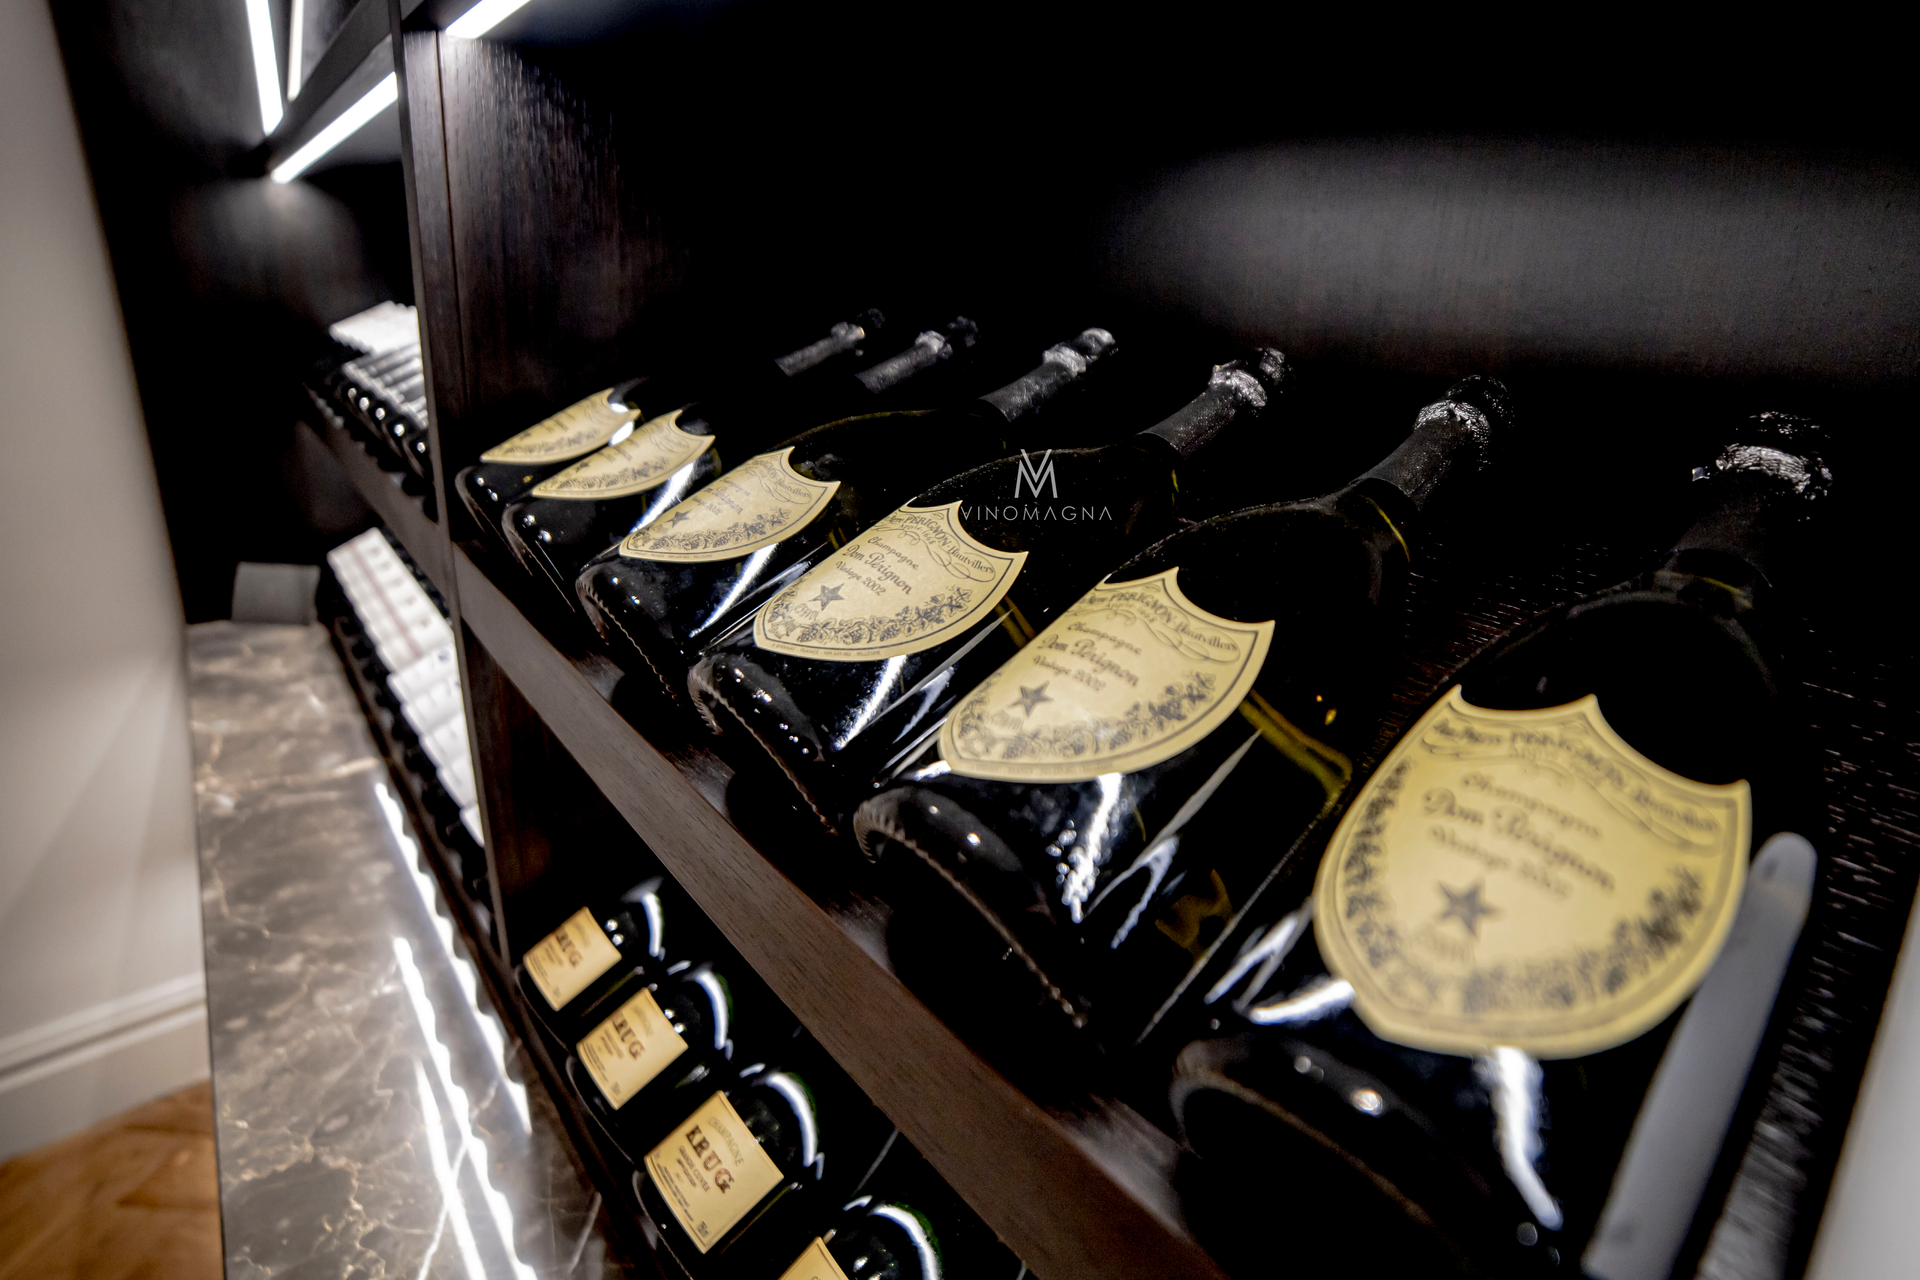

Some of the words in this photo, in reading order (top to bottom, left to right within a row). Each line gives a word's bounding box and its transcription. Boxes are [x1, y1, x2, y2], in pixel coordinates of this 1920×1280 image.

[842, 544, 865, 561] Dom
[864, 551, 912, 595] Pérignon
[868, 536, 919, 571] Champagne
[948, 545, 995, 574] Hautvillers
[835, 561, 862, 581] Vintage
[861, 576, 886, 596] 2002
[1067, 621, 1142, 656] Champagne
[1175, 621, 1239, 652] Hautvillers
[685, 1124, 735, 1194] KRUG
